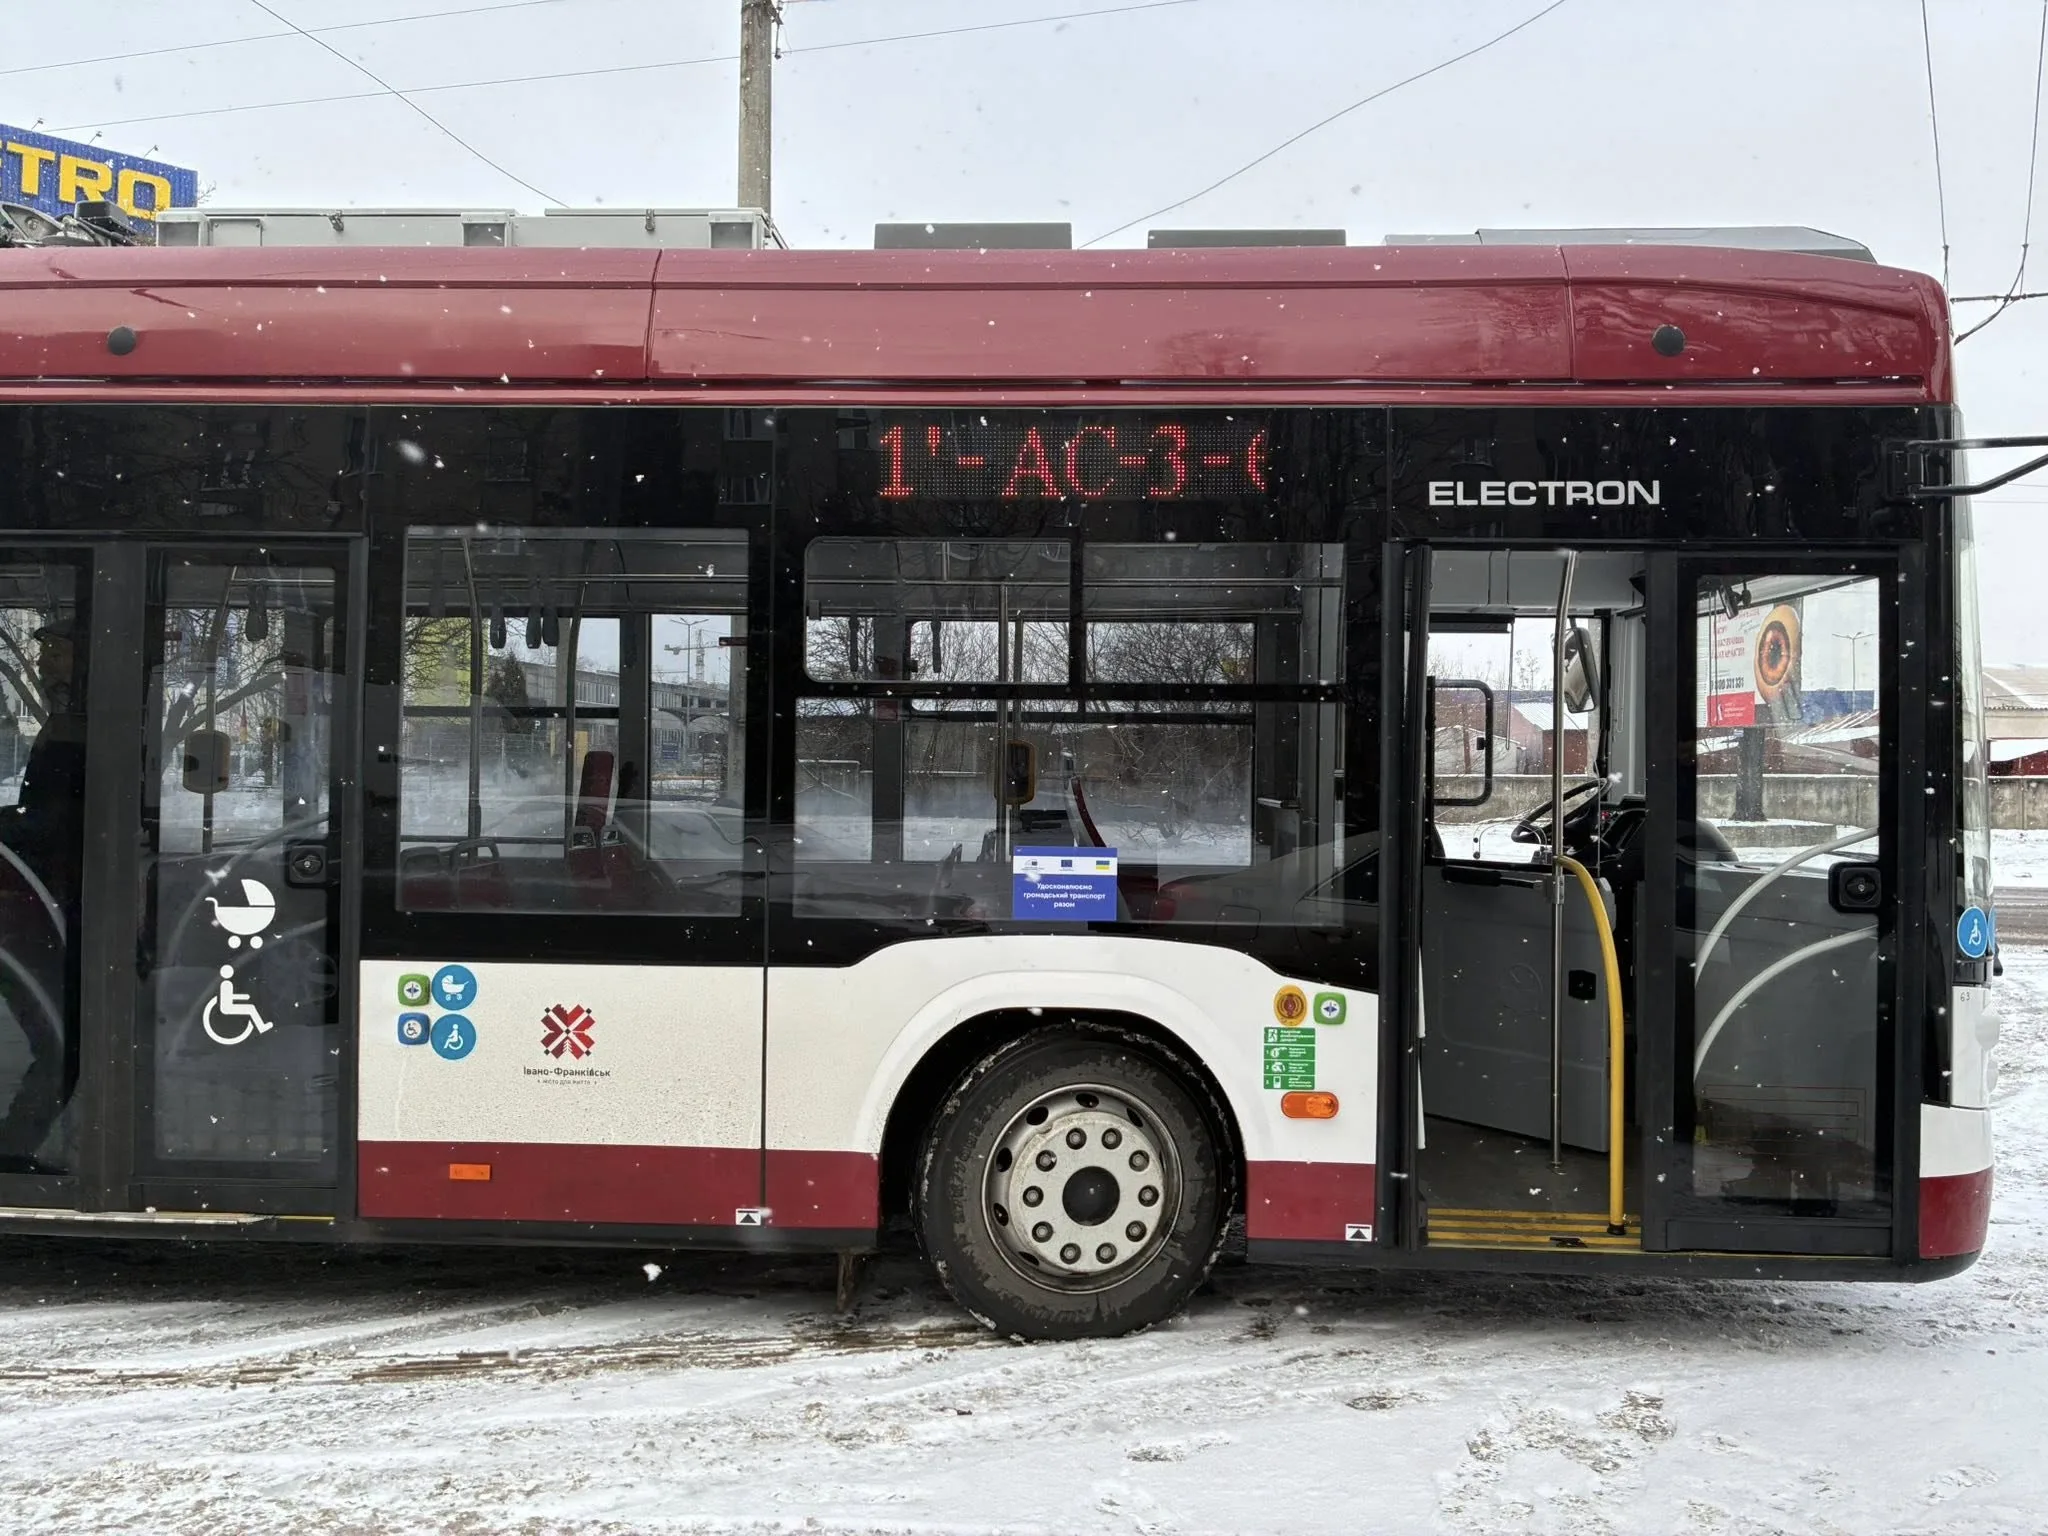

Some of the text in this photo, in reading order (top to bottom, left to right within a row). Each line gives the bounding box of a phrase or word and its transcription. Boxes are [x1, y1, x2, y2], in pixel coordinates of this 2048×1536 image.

[0, 139, 172, 220] TRO
[1428, 480, 1661, 506] ELECTRON
[1023, 892, 1068, 900] громадський
[1960, 991, 1971, 1002] 63
[523, 1066, 611, 1077] Івано-Франківськ
